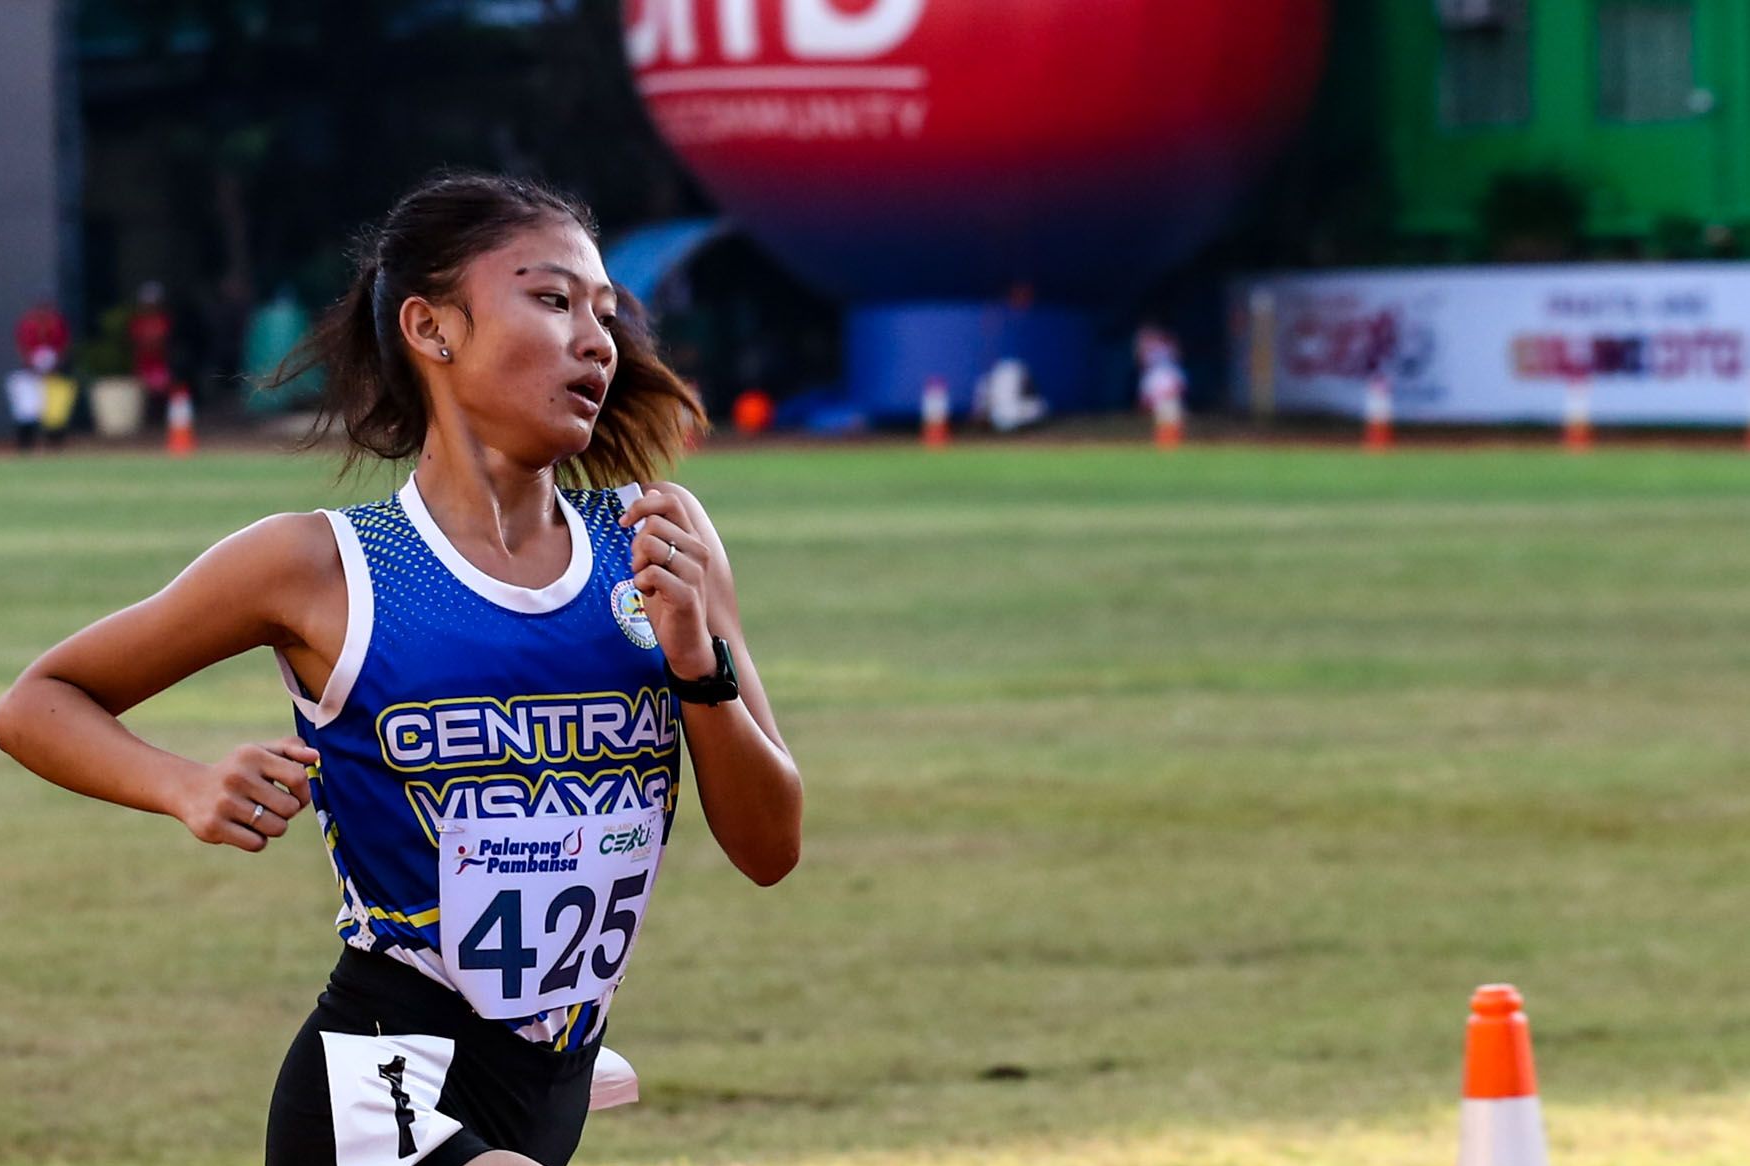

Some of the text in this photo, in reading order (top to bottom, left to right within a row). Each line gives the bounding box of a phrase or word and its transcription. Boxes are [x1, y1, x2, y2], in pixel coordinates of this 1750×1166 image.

[381, 693, 677, 764] CENTRAL
[479, 836, 562, 859] Palarong
[486, 855, 578, 874] Pambansa
[457, 868, 649, 1000] 425
